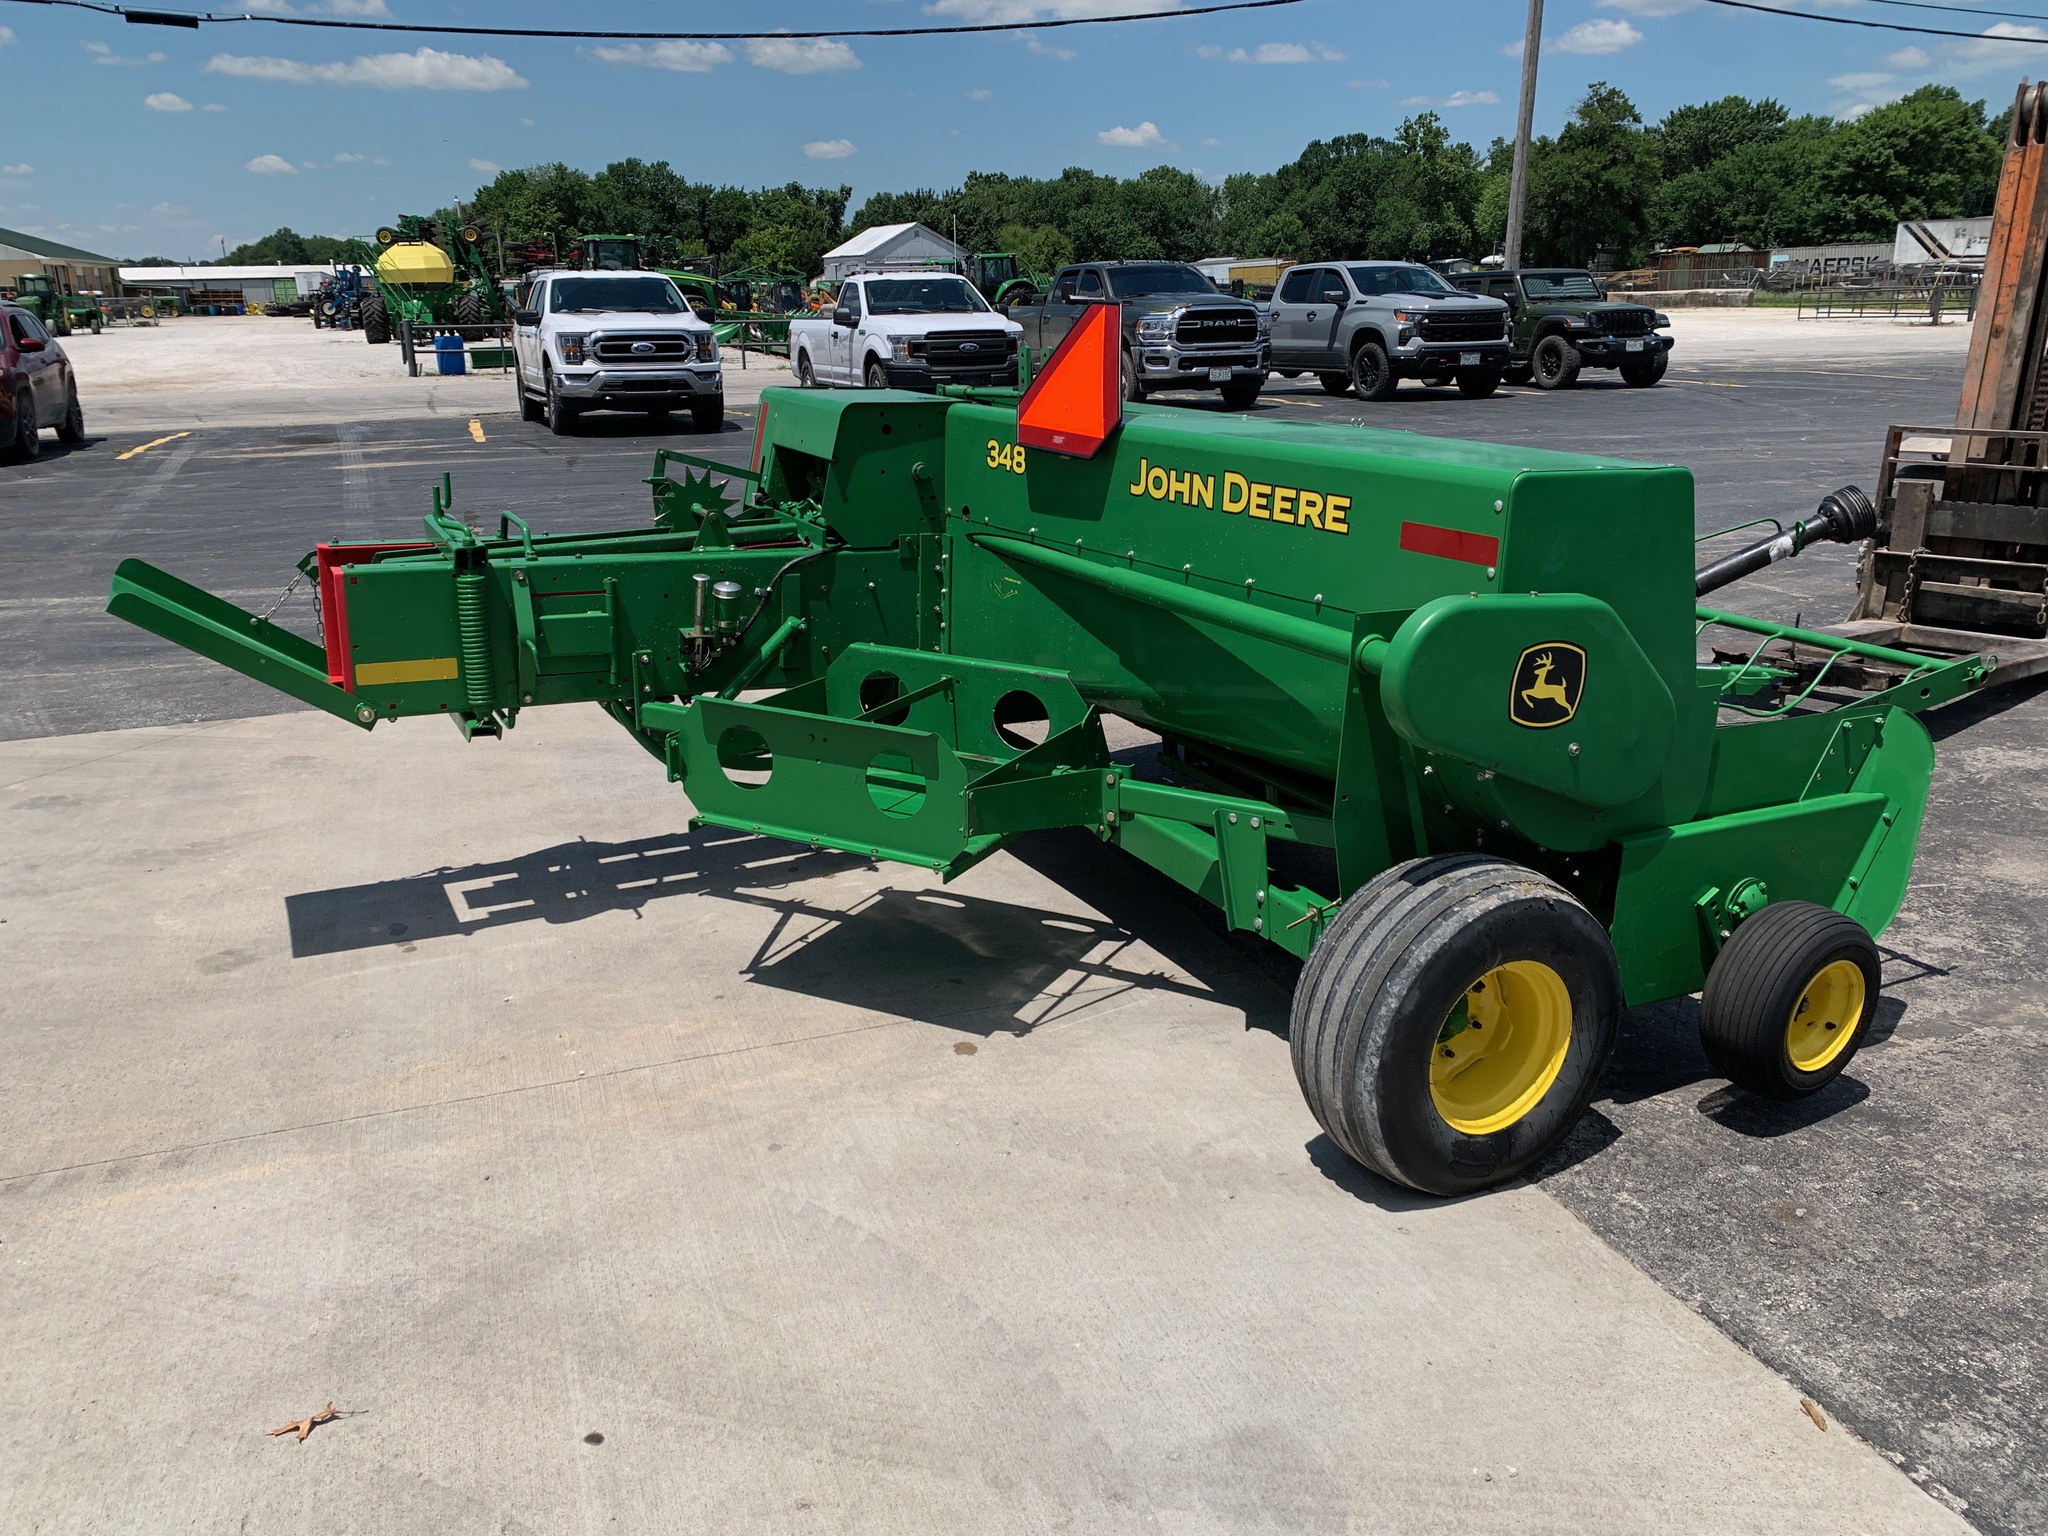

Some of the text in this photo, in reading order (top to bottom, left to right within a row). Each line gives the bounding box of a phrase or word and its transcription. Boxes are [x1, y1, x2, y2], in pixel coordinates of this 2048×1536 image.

[1202, 318, 1237, 327] RAM
[986, 438, 1027, 476] 348
[1130, 457, 1352, 536] JOHN DEERE
